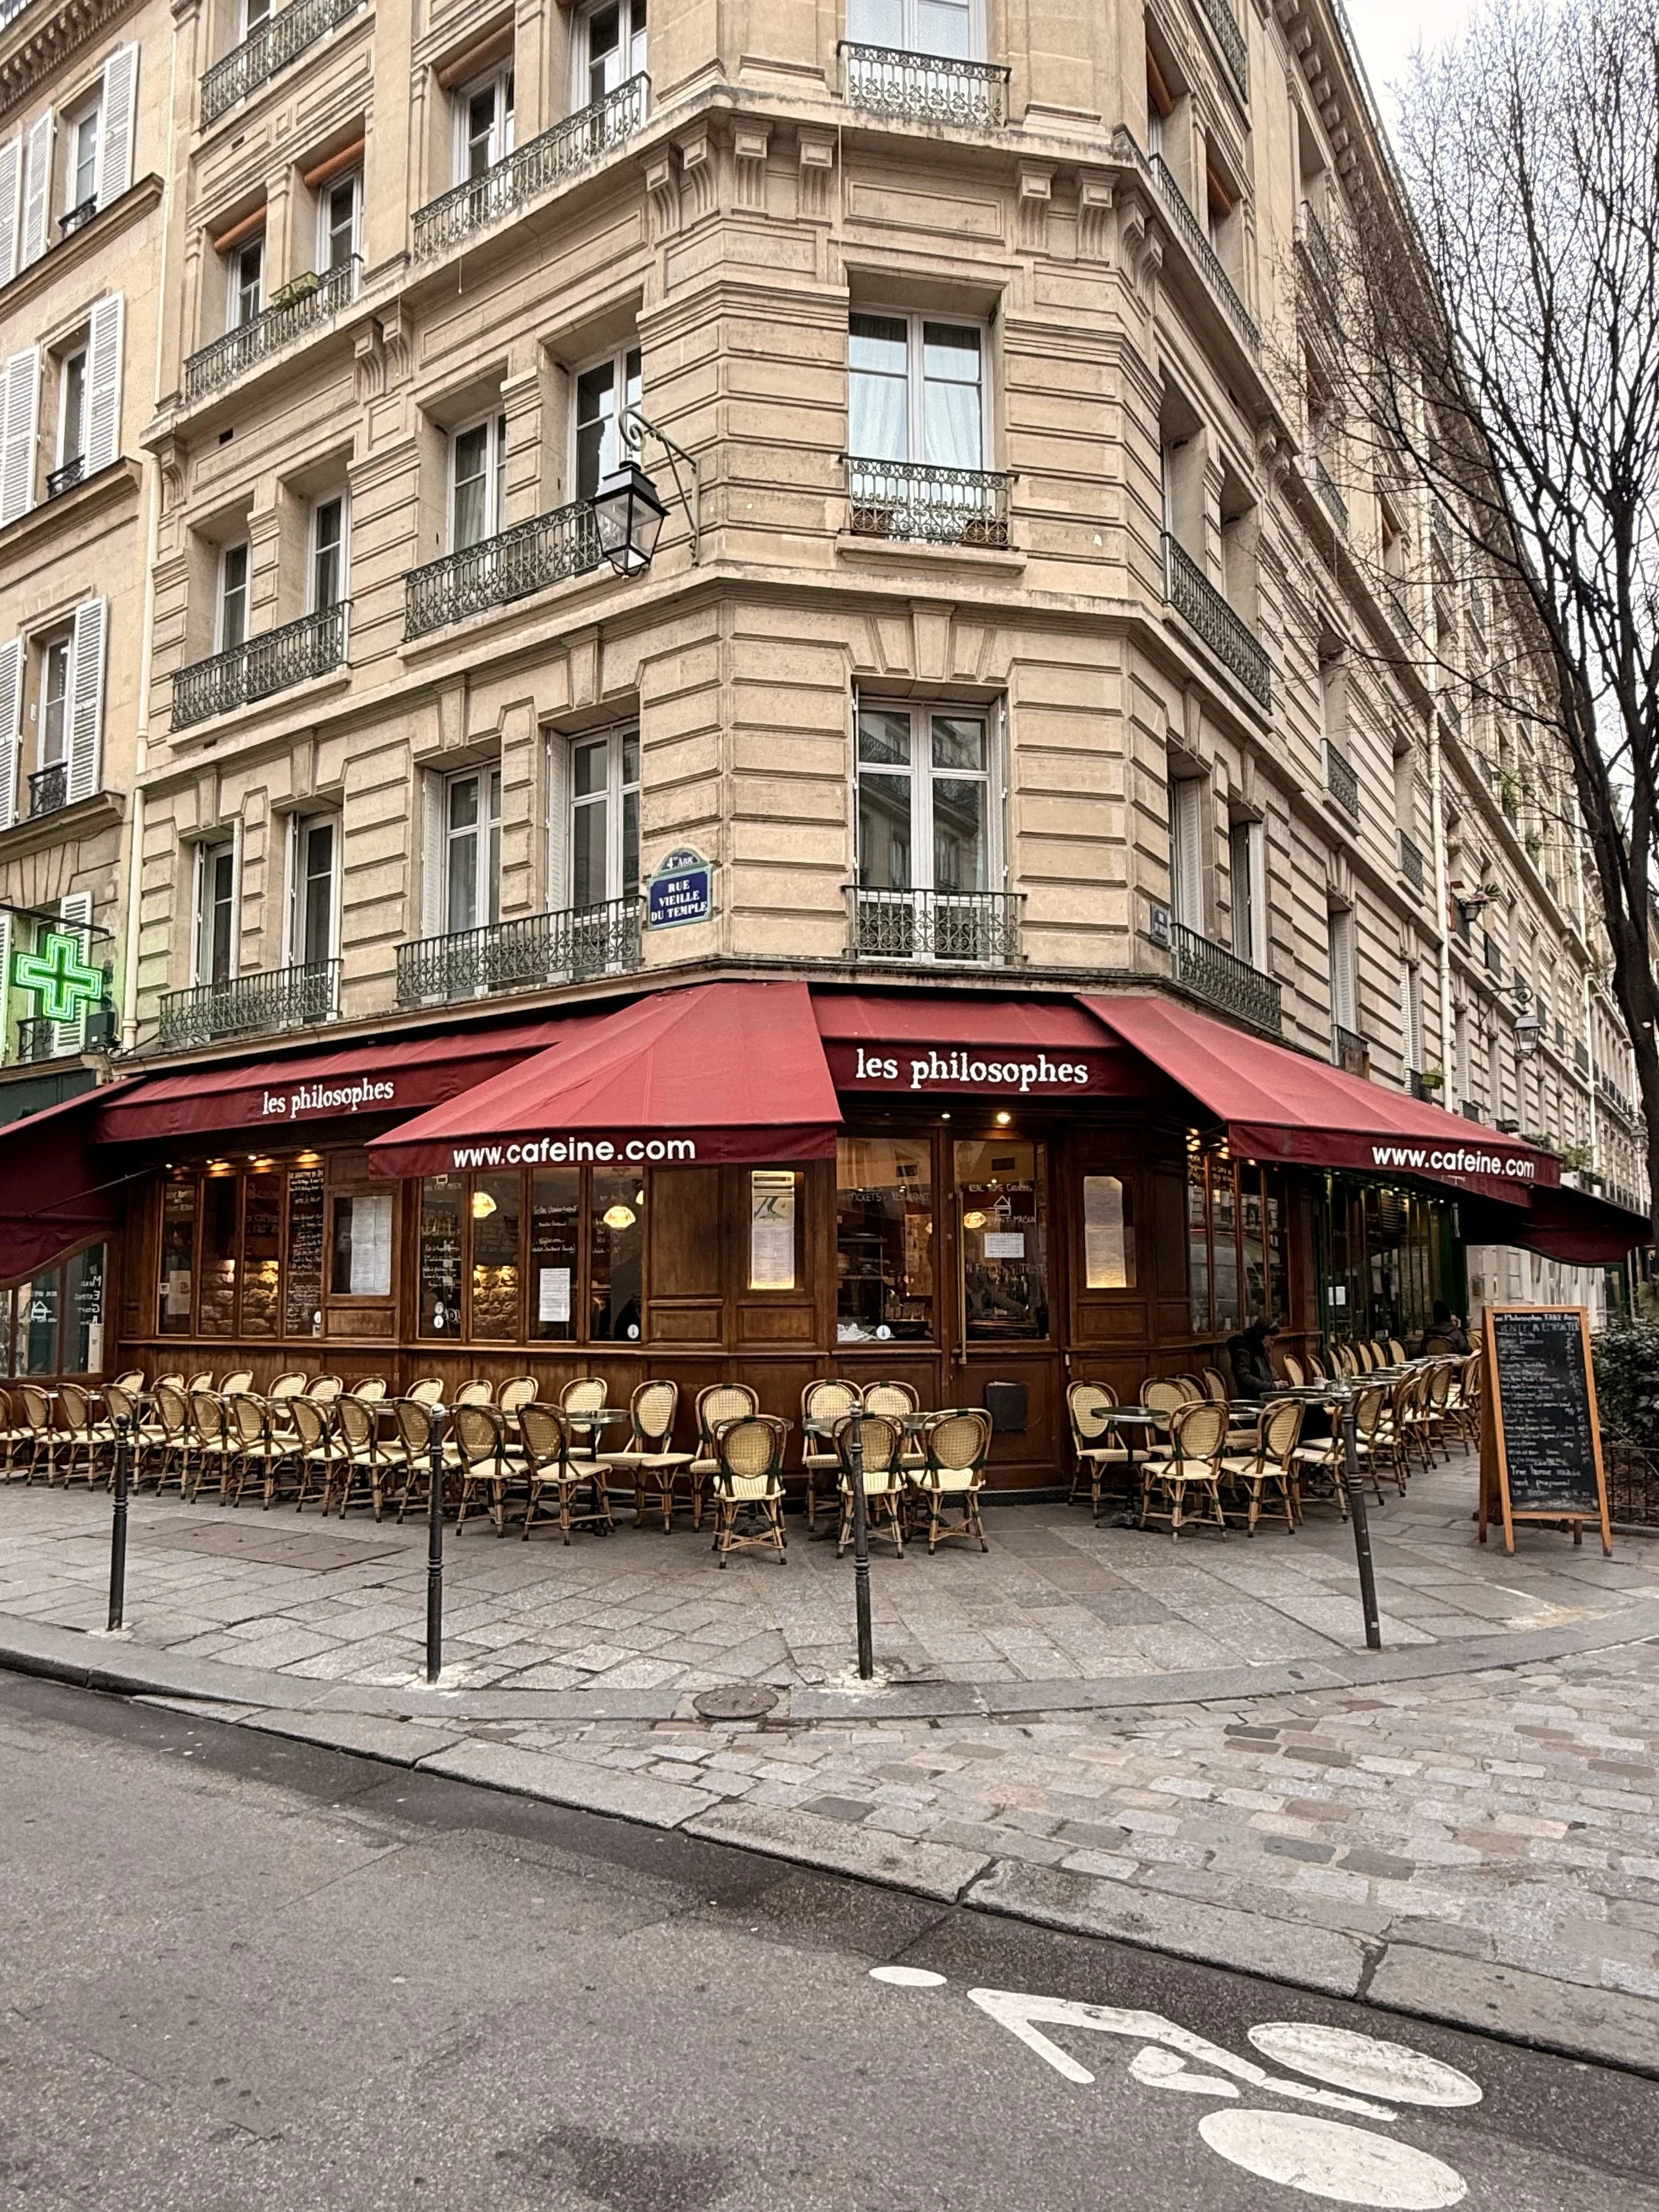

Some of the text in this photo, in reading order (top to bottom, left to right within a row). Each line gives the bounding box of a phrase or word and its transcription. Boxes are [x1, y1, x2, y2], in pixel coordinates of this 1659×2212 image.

[658, 890, 700, 908] VIEILLE
[668, 880, 690, 893] RUE
[651, 901, 707, 922] DU TEMPLE
[856, 1048, 1089, 1092] les philosophes
[262, 1077, 394, 1119] les philosophes
[453, 1137, 696, 1168] www.cafeine.com
[1372, 1146, 1535, 1178] www.cafeine.com
